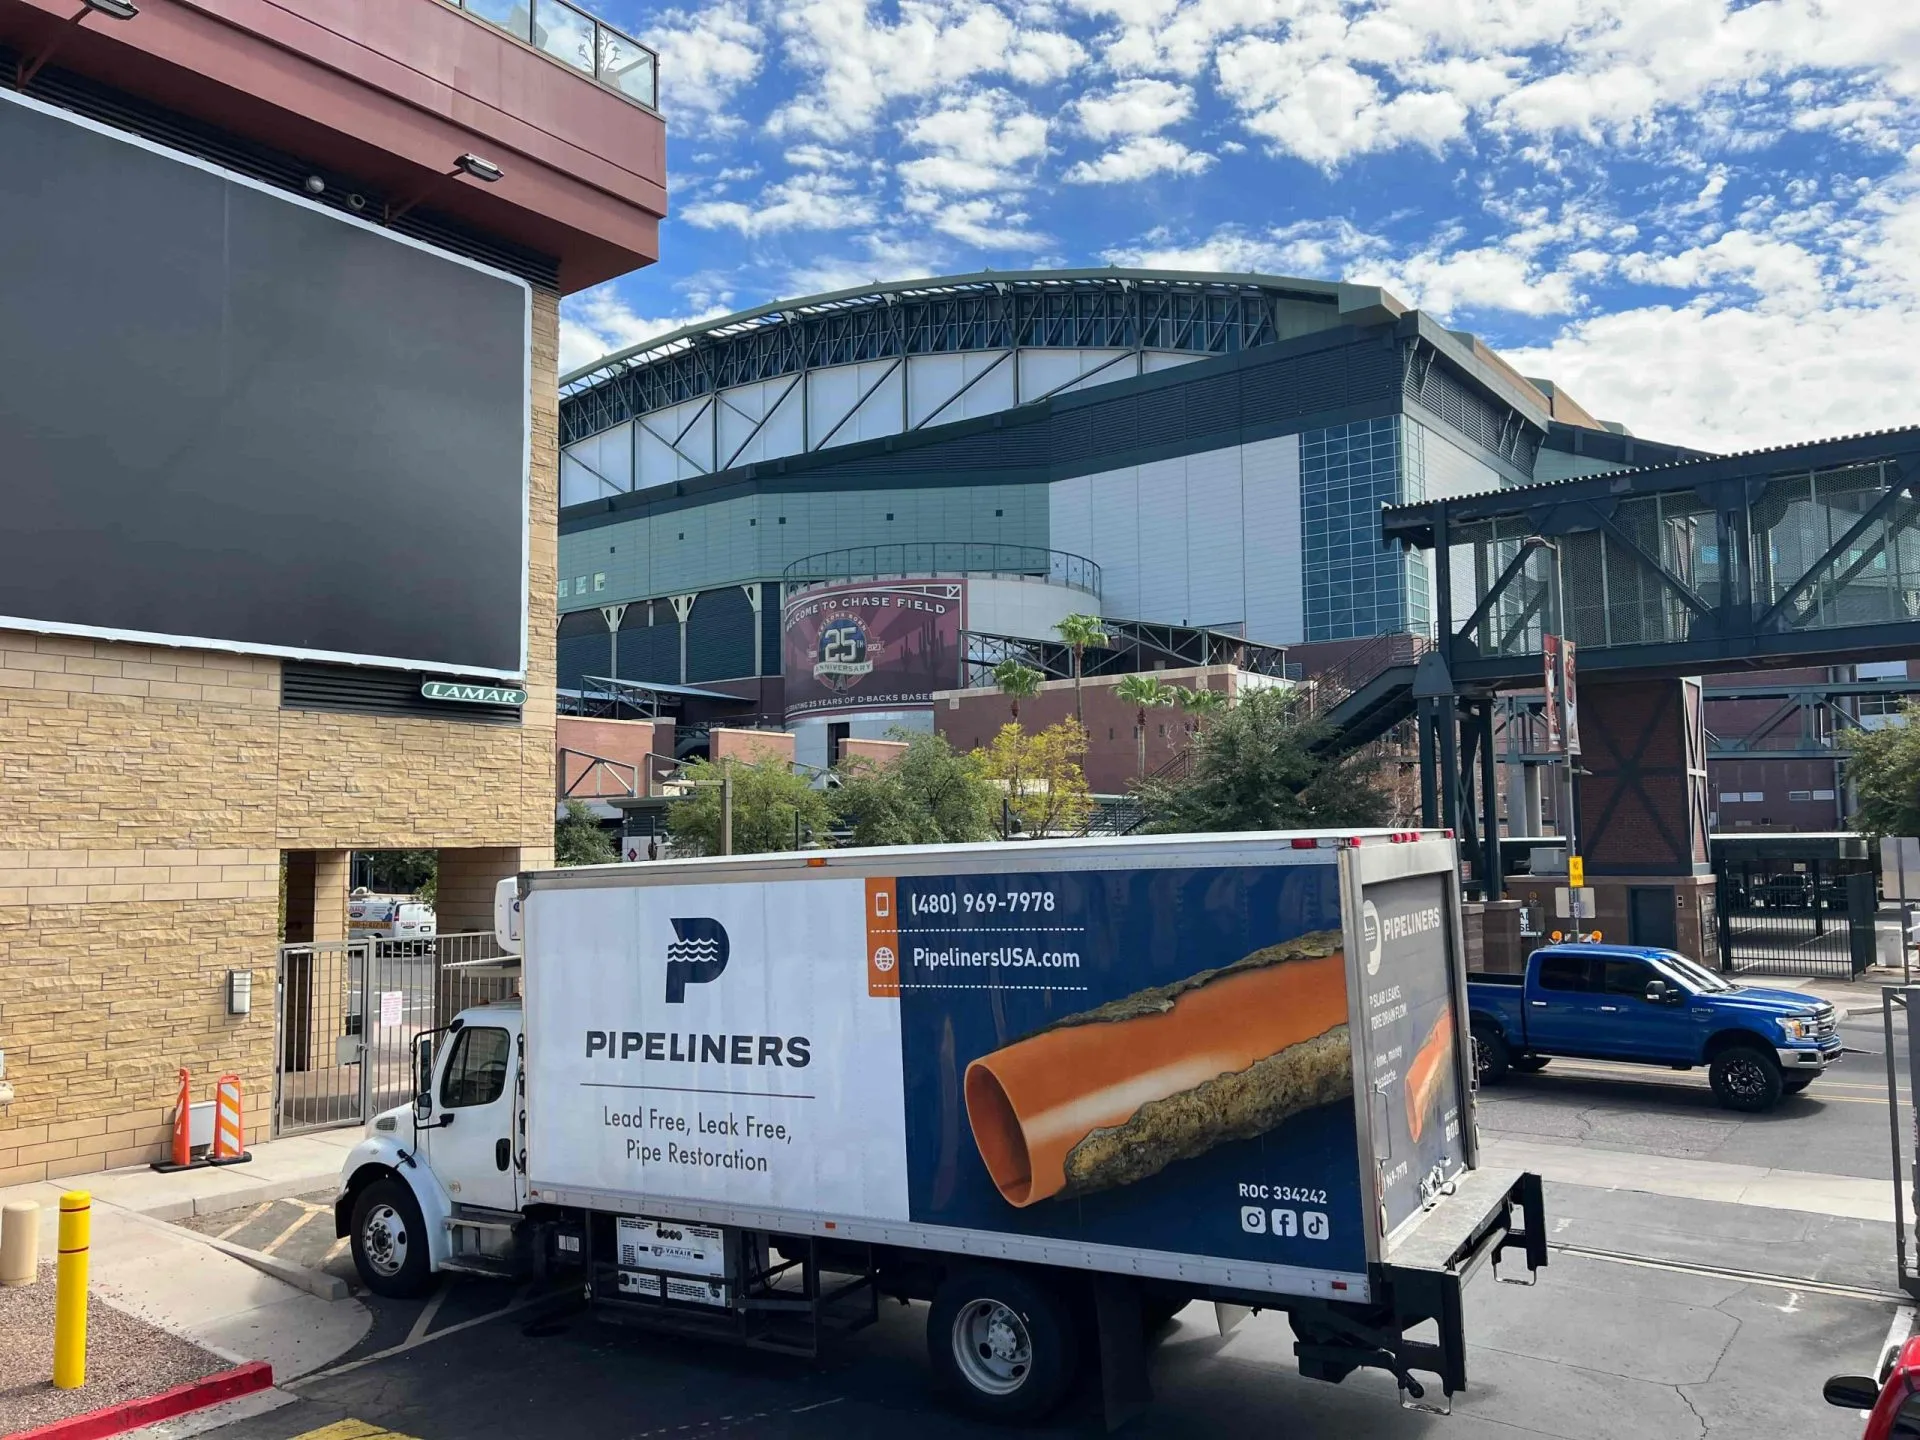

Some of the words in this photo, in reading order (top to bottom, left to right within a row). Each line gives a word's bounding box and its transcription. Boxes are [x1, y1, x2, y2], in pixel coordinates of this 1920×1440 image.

[822, 600, 837, 611] TO
[842, 597, 890, 608] CHASE
[897, 598, 946, 615] FIELD
[824, 626, 857, 663] 25
[815, 662, 872, 672] ANNIVERSARY
[431, 684, 517, 702] LAMAR
[809, 700, 817, 708] 25
[818, 697, 842, 707] YEARS
[844, 696, 855, 704] OF
[857, 693, 898, 703] D-BACKS
[911, 892, 957, 916] (480)
[963, 891, 1056, 912] 969-7978
[1383, 907, 1440, 941] PIPELINERS
[912, 946, 1081, 971] PipelinersUSA.com
[585, 1031, 812, 1068] PIPELINERS
[604, 1106, 642, 1128] Lead
[650, 1109, 691, 1135] Free,
[699, 1112, 739, 1136] Leak
[746, 1116, 792, 1143] Free,
[626, 1139, 662, 1165] Pipe
[668, 1142, 768, 1172] Restoration
[1239, 1183, 1269, 1199] ROC
[1273, 1186, 1328, 1204] 334242
